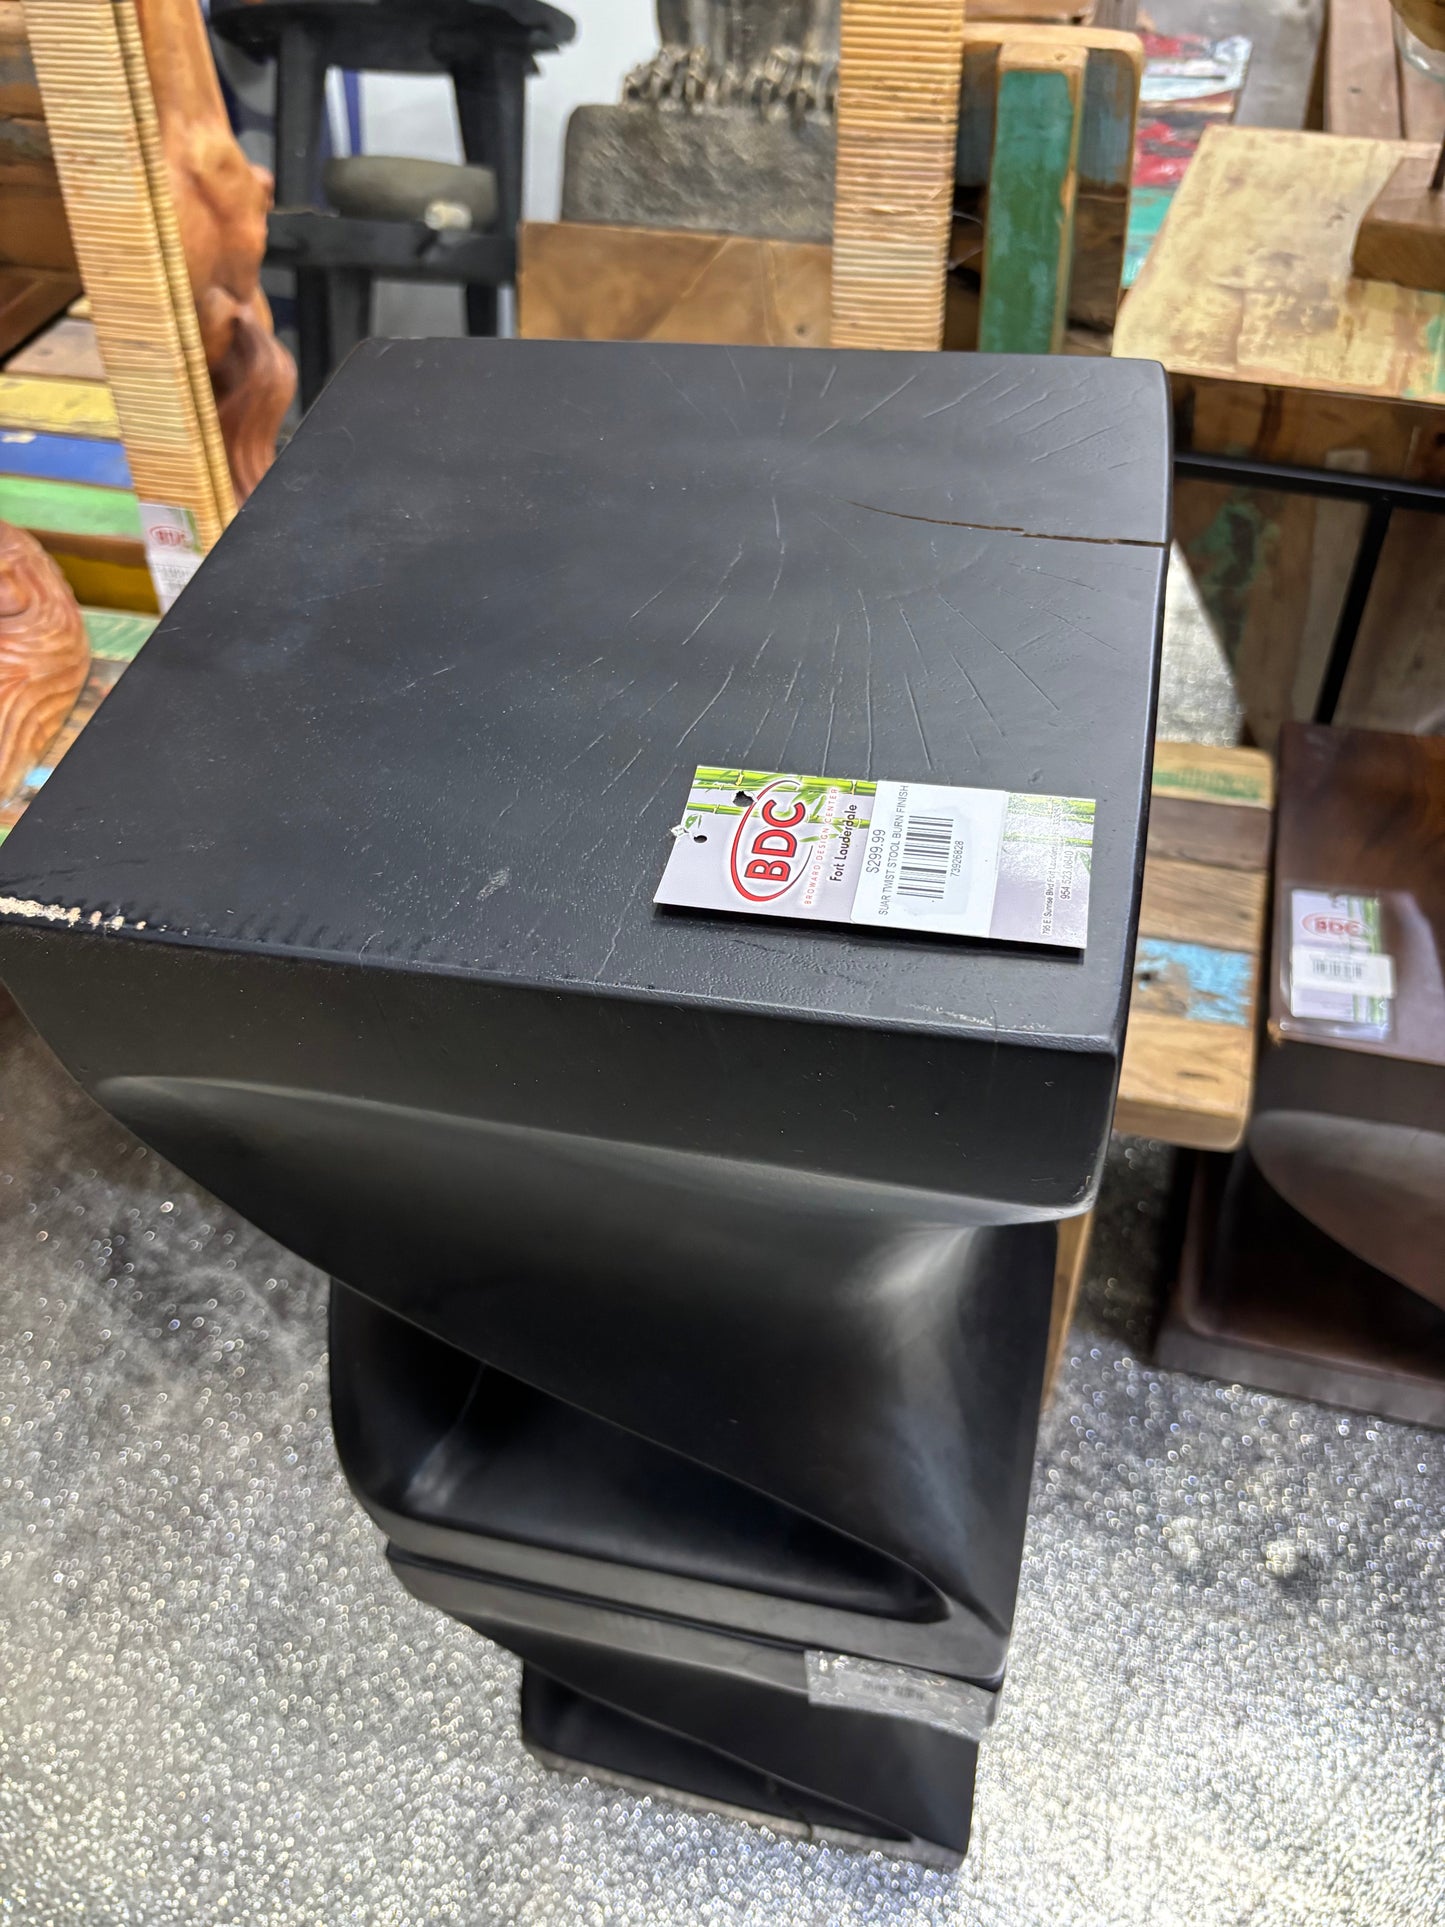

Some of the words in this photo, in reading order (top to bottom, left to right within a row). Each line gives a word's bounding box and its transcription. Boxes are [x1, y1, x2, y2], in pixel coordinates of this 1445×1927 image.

[896, 785, 910, 814] FINISH
[835, 804, 858, 860] Lauderdale
[892, 815, 904, 839] BURN
[744, 800, 806, 882] BDC
[803, 864, 821, 905] BROWARD
[815, 828, 830, 861] DESIGN
[824, 787, 838, 824] CENTER
[865, 829, 886, 874] $299.99
[887, 841, 900, 868] STOOL
[949, 840, 964, 877] 73926828
[829, 862, 846, 882] Fort
[882, 869, 896, 893] TWIST
[1046, 883, 1055, 896] Blvd
[878, 895, 890, 916] SUAR
[1044, 896, 1054, 918] Sunrise
[1314, 916, 1360, 936] BDC
